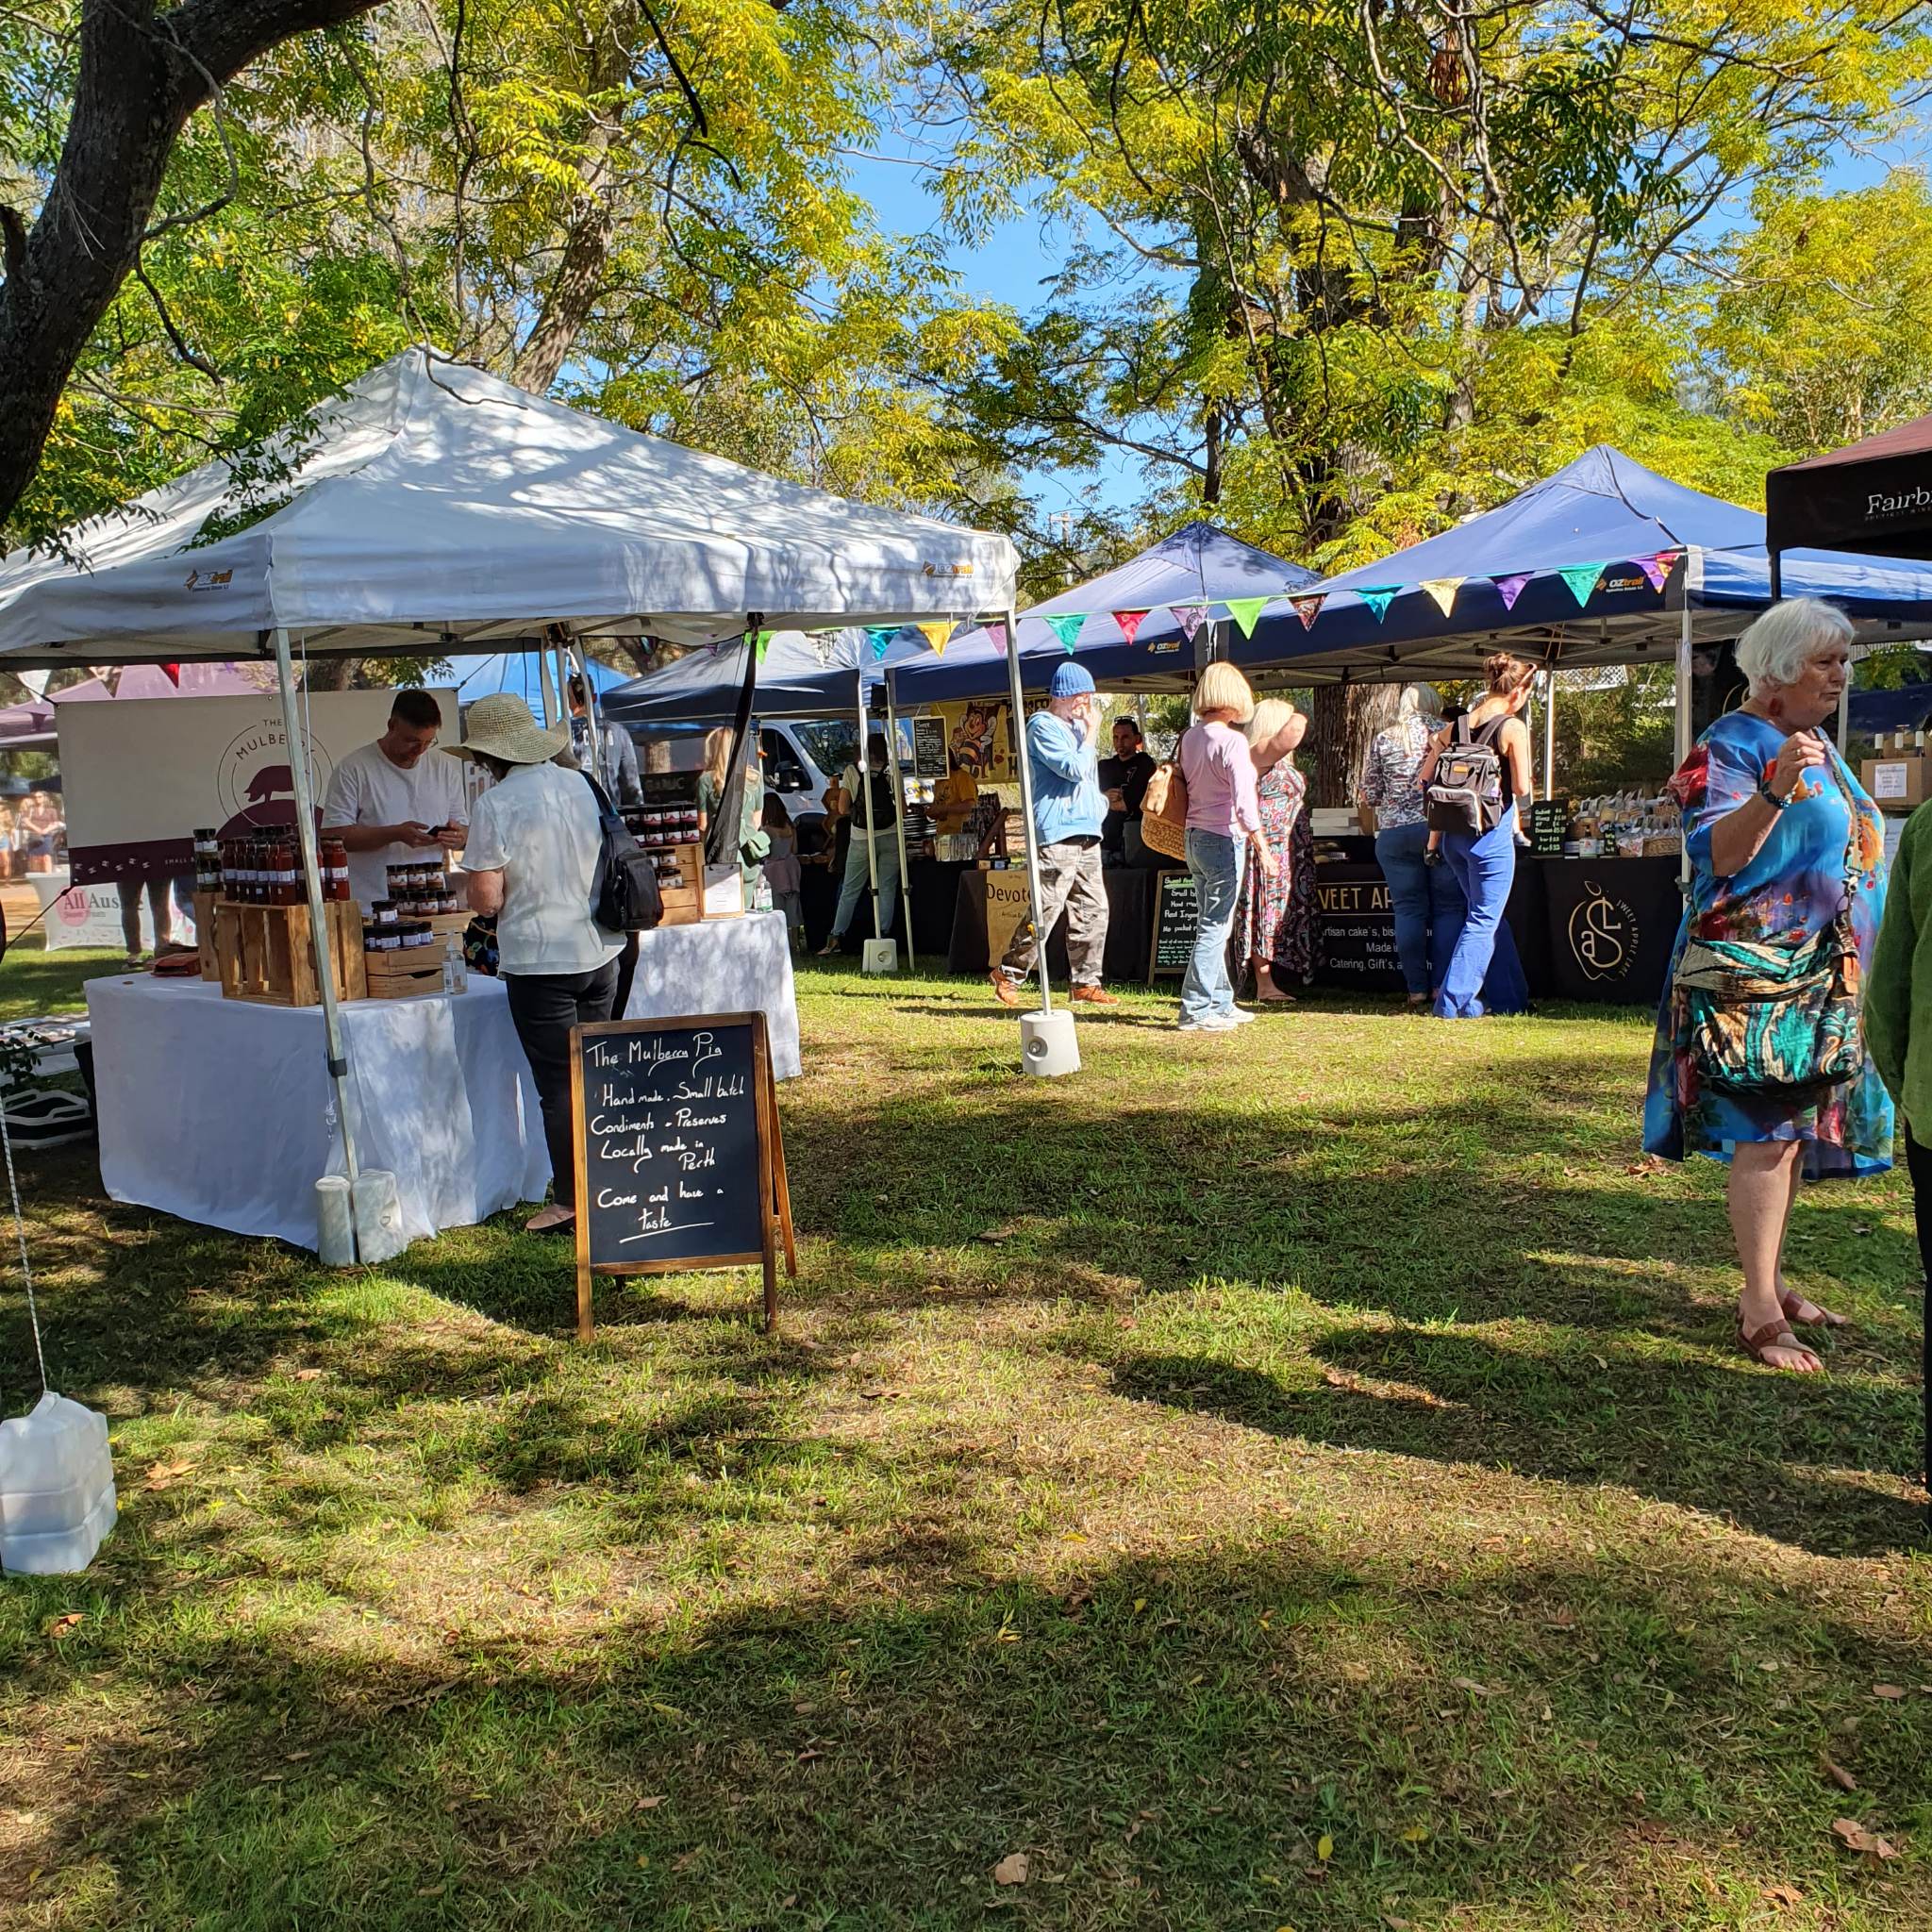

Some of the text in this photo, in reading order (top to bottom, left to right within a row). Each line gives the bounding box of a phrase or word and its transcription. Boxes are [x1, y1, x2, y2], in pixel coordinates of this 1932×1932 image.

[1866, 486, 1932, 514] Fairb
[263, 718, 283, 726] THE
[64, 892, 86, 909] All
[1322, 926, 1345, 937] rtisan
[1366, 942, 1391, 953] Made
[586, 1041, 619, 1067] The
[692, 1032, 723, 1078] Pig
[673, 1075, 713, 1100] Small
[716, 1074, 744, 1098] batch
[591, 1111, 655, 1136] Condiments
[675, 1108, 727, 1128] Preserves
[600, 1134, 705, 1174] Locally made in
[678, 1147, 716, 1172] Perth
[597, 1188, 638, 1208] Come
[648, 1186, 669, 1203] and
[679, 1180, 704, 1199] have
[638, 1206, 673, 1231] taste
